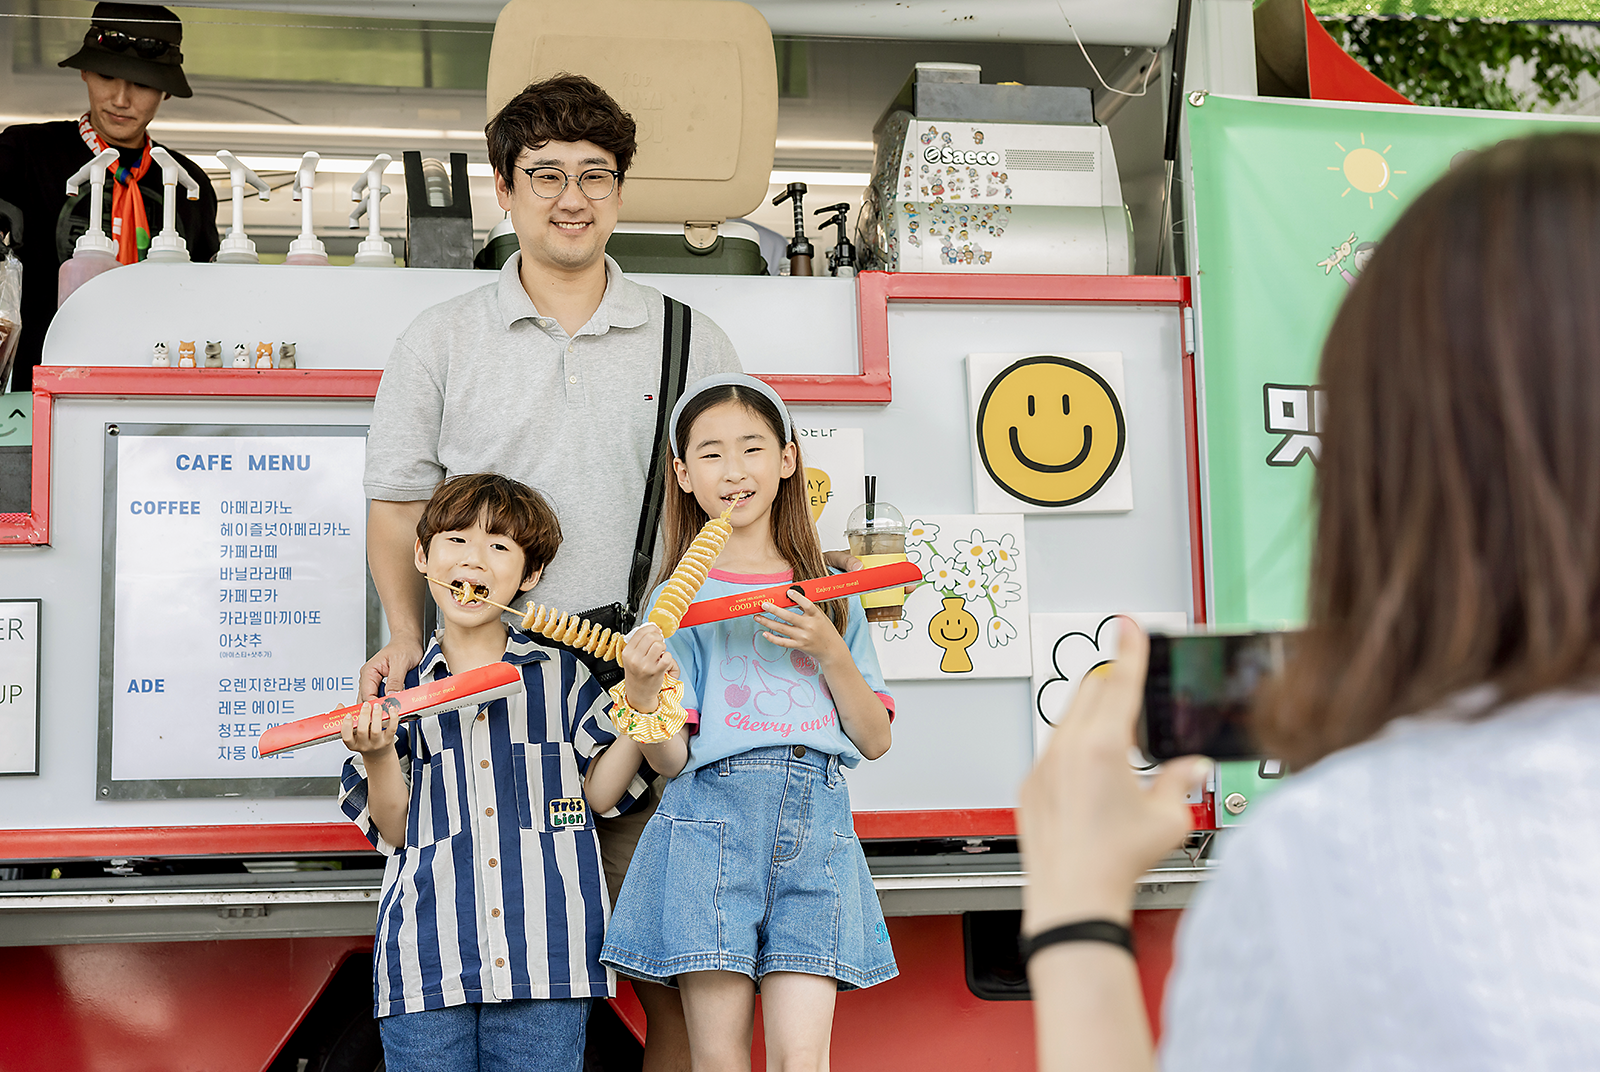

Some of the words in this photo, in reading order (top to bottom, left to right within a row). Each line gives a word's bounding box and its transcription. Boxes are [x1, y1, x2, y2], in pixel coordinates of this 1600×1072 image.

[941, 146, 1000, 166] Saeco
[176, 454, 233, 471] CAFE
[248, 454, 311, 471] MENU
[130, 501, 201, 515] COFFEE
[220, 501, 293, 515] 아메리카노
[220, 522, 351, 538] 헤이즐넛아메리카노
[220, 544, 278, 559] 카페라떼
[219, 566, 292, 582] 바닐라라떼
[815, 585, 831, 594] Enjoy
[832, 583, 846, 591] your
[845, 579, 860, 588] meal
[219, 589, 279, 604] 카페모카
[729, 602, 752, 612] GOOD
[219, 610, 322, 626] 카라멜마끼아또
[219, 633, 263, 648] 아샷추
[127, 678, 165, 694] ADE
[218, 677, 307, 693] 오렌지한라봉
[311, 676, 354, 692] 에이드
[218, 700, 247, 716] 레몬
[251, 700, 295, 715] 에이드
[218, 723, 261, 738] 청포도
[724, 711, 795, 738] Cherry
[218, 745, 247, 761] 자몽
[551, 798, 583, 813] Très
[554, 813, 584, 825] bien
